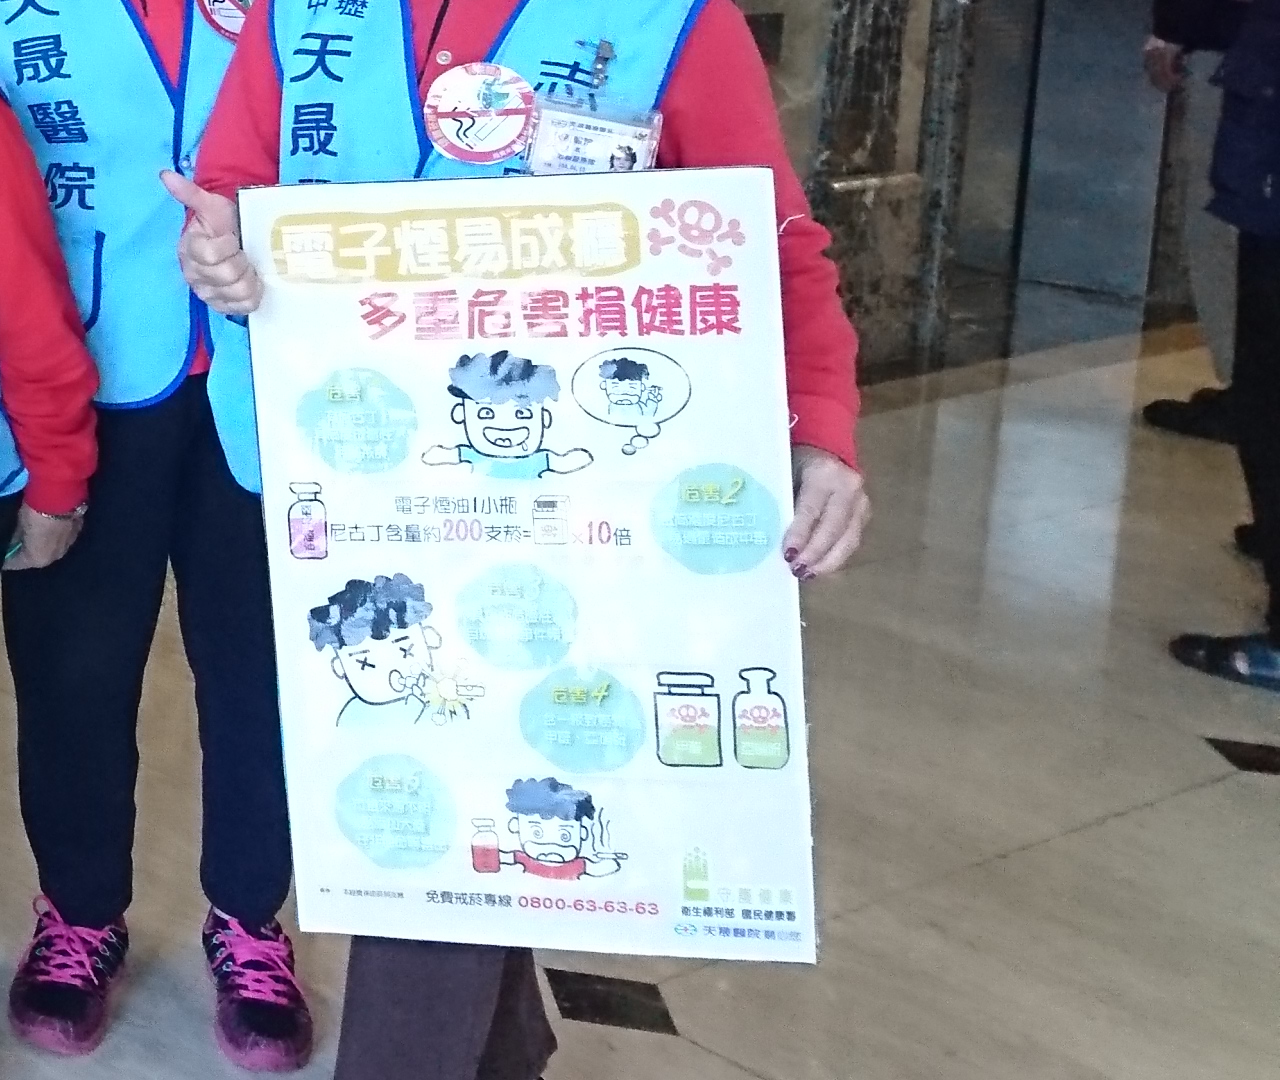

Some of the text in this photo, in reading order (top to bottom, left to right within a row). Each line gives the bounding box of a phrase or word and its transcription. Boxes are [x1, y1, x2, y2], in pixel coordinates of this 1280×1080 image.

[281, 210, 626, 280] 電子煙易成癮
[359, 283, 743, 341] 多重危害損健康
[426, 890, 513, 909] 免費戒菸專線
[517, 895, 659, 916] 0800-63-63-63
